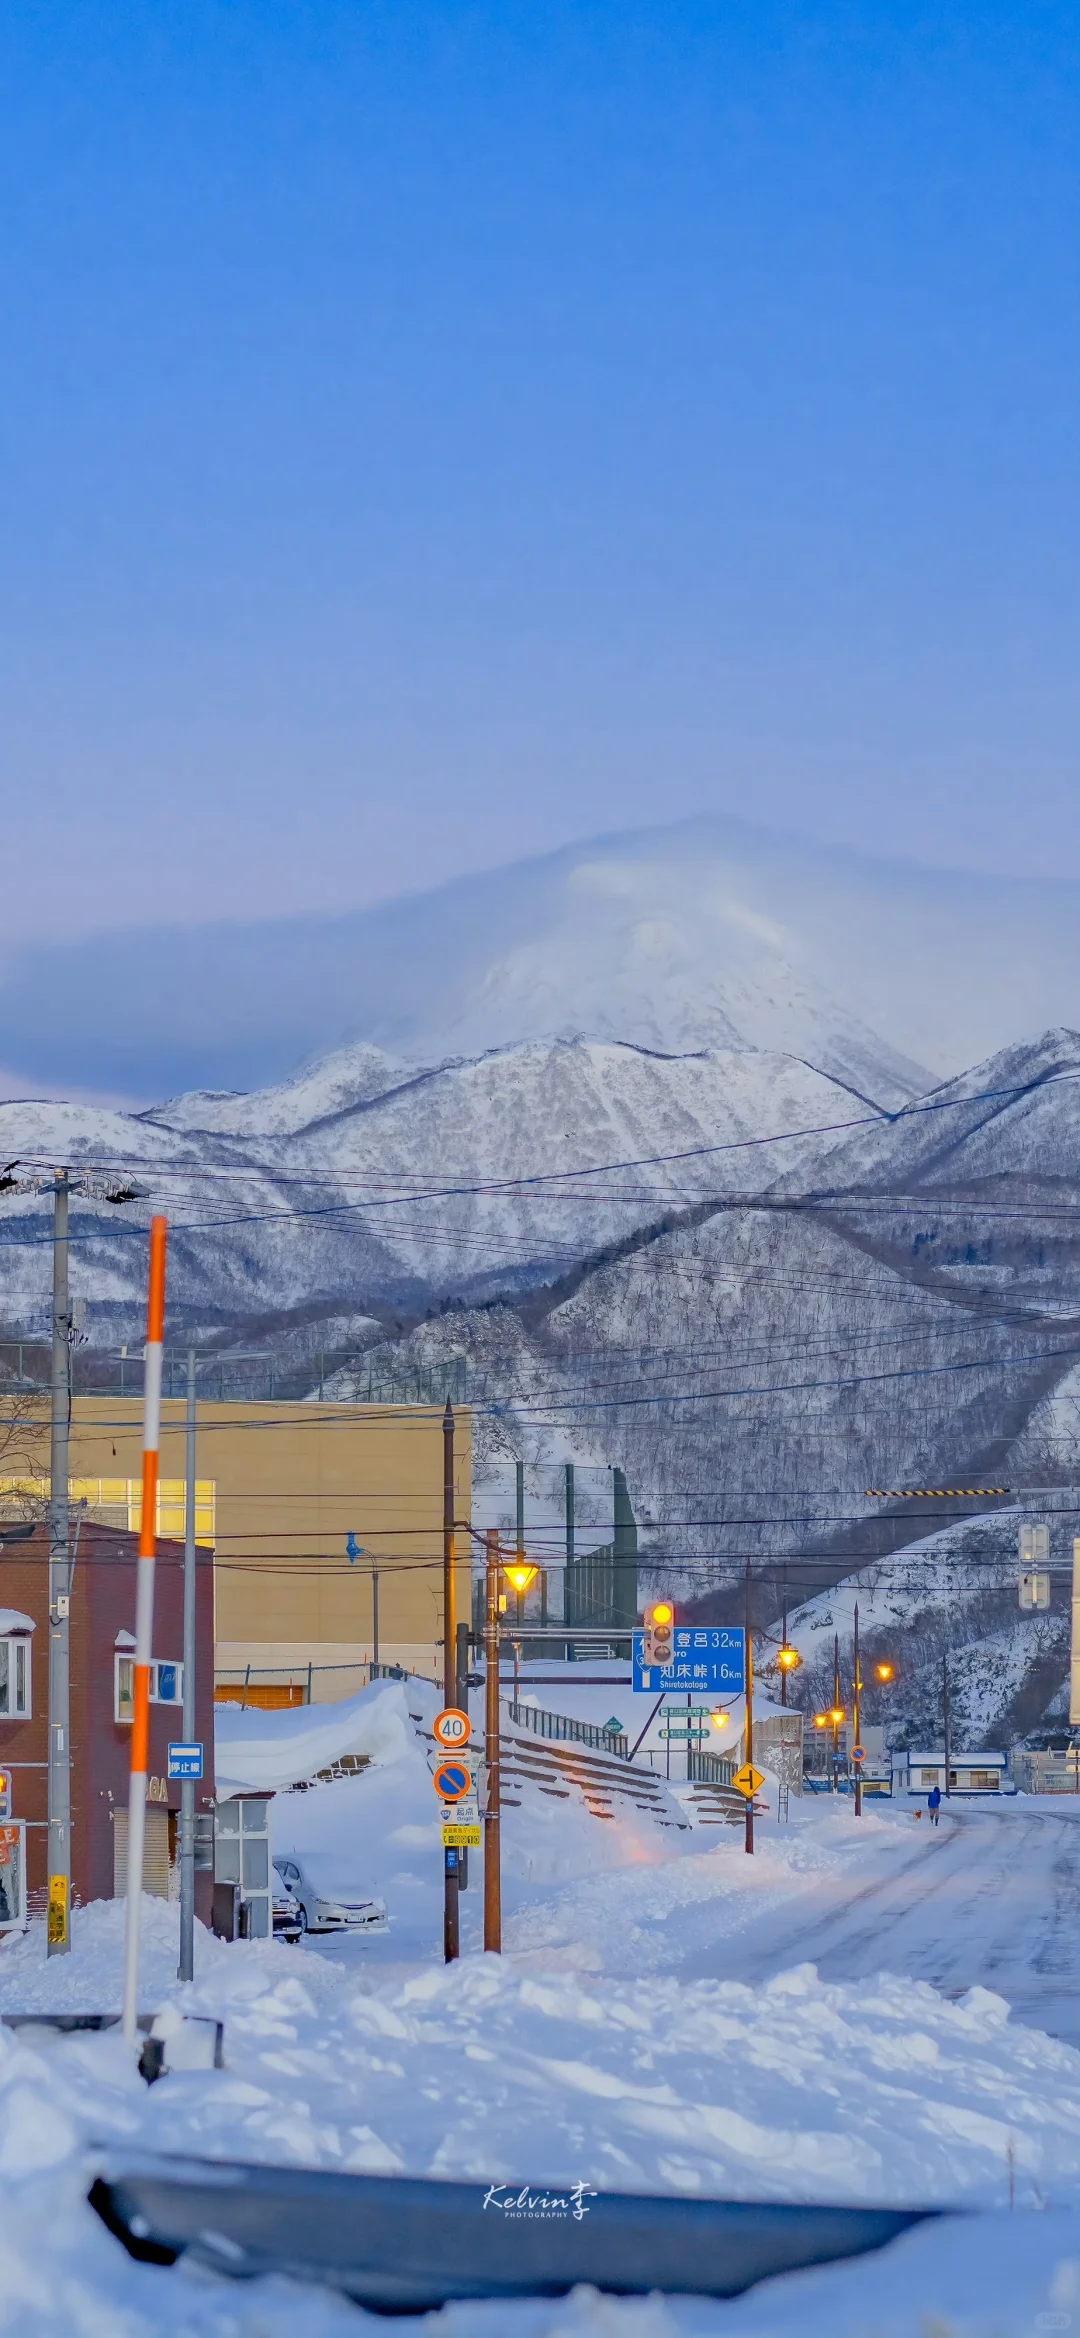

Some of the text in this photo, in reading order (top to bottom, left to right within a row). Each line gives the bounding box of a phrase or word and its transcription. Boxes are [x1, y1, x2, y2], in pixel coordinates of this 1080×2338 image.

[711, 1632, 742, 1648] 32Km
[660, 1663, 742, 1679] 知床峠 16Km
[442, 1720, 462, 1736] 40
[171, 1762, 200, 1773] 停止線
